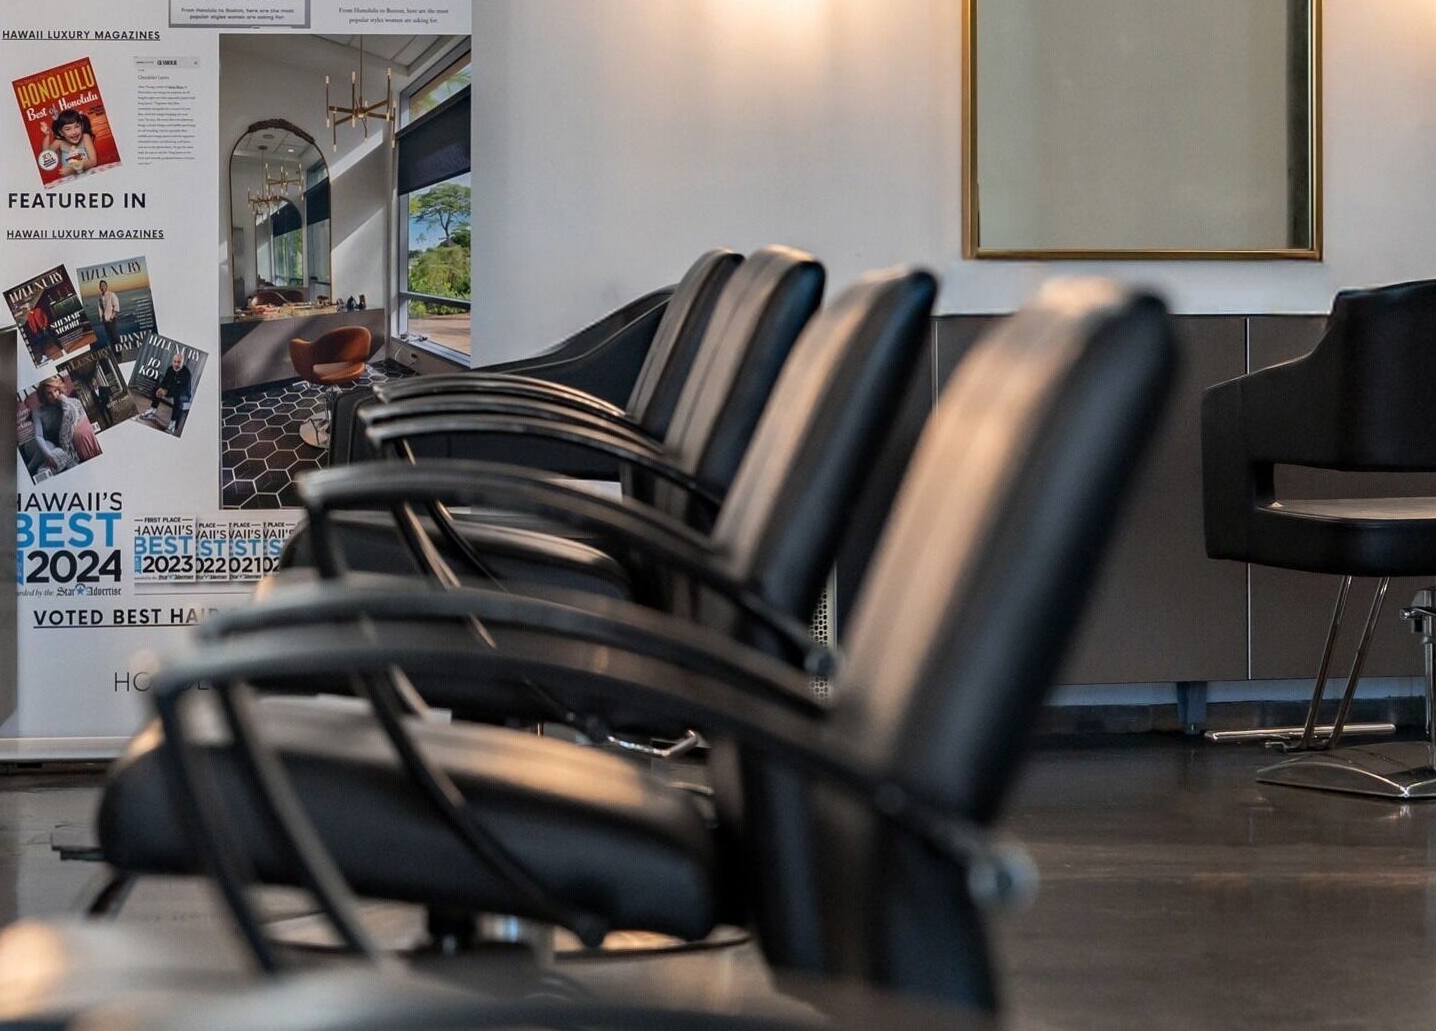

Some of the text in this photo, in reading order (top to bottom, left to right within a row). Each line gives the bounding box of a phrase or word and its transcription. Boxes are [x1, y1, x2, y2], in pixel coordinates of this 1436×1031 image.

[3, 31, 160, 40] HAWAII LUXURY MAGAZINES
[18, 64, 95, 108] HONOLULU
[27, 108, 47, 121] Best
[59, 91, 98, 111] Honolulu
[9, 193, 146, 208] FEATURED IN
[7, 230, 164, 239] HAWAII LUXURY MAGAZINES
[148, 358, 160, 367] JO
[139, 366, 159, 379] KOY
[17, 512, 122, 548] BEST
[135, 536, 192, 554] BEST
[26, 550, 122, 583] 2024
[143, 556, 193, 573] 2023
[196, 558, 226, 573] 022
[230, 558, 260, 573] 021
[36, 589, 42, 597] by
[86, 587, 121, 596] Advertise
[34, 610, 103, 625] VOTED
[114, 609, 161, 624] BEST
